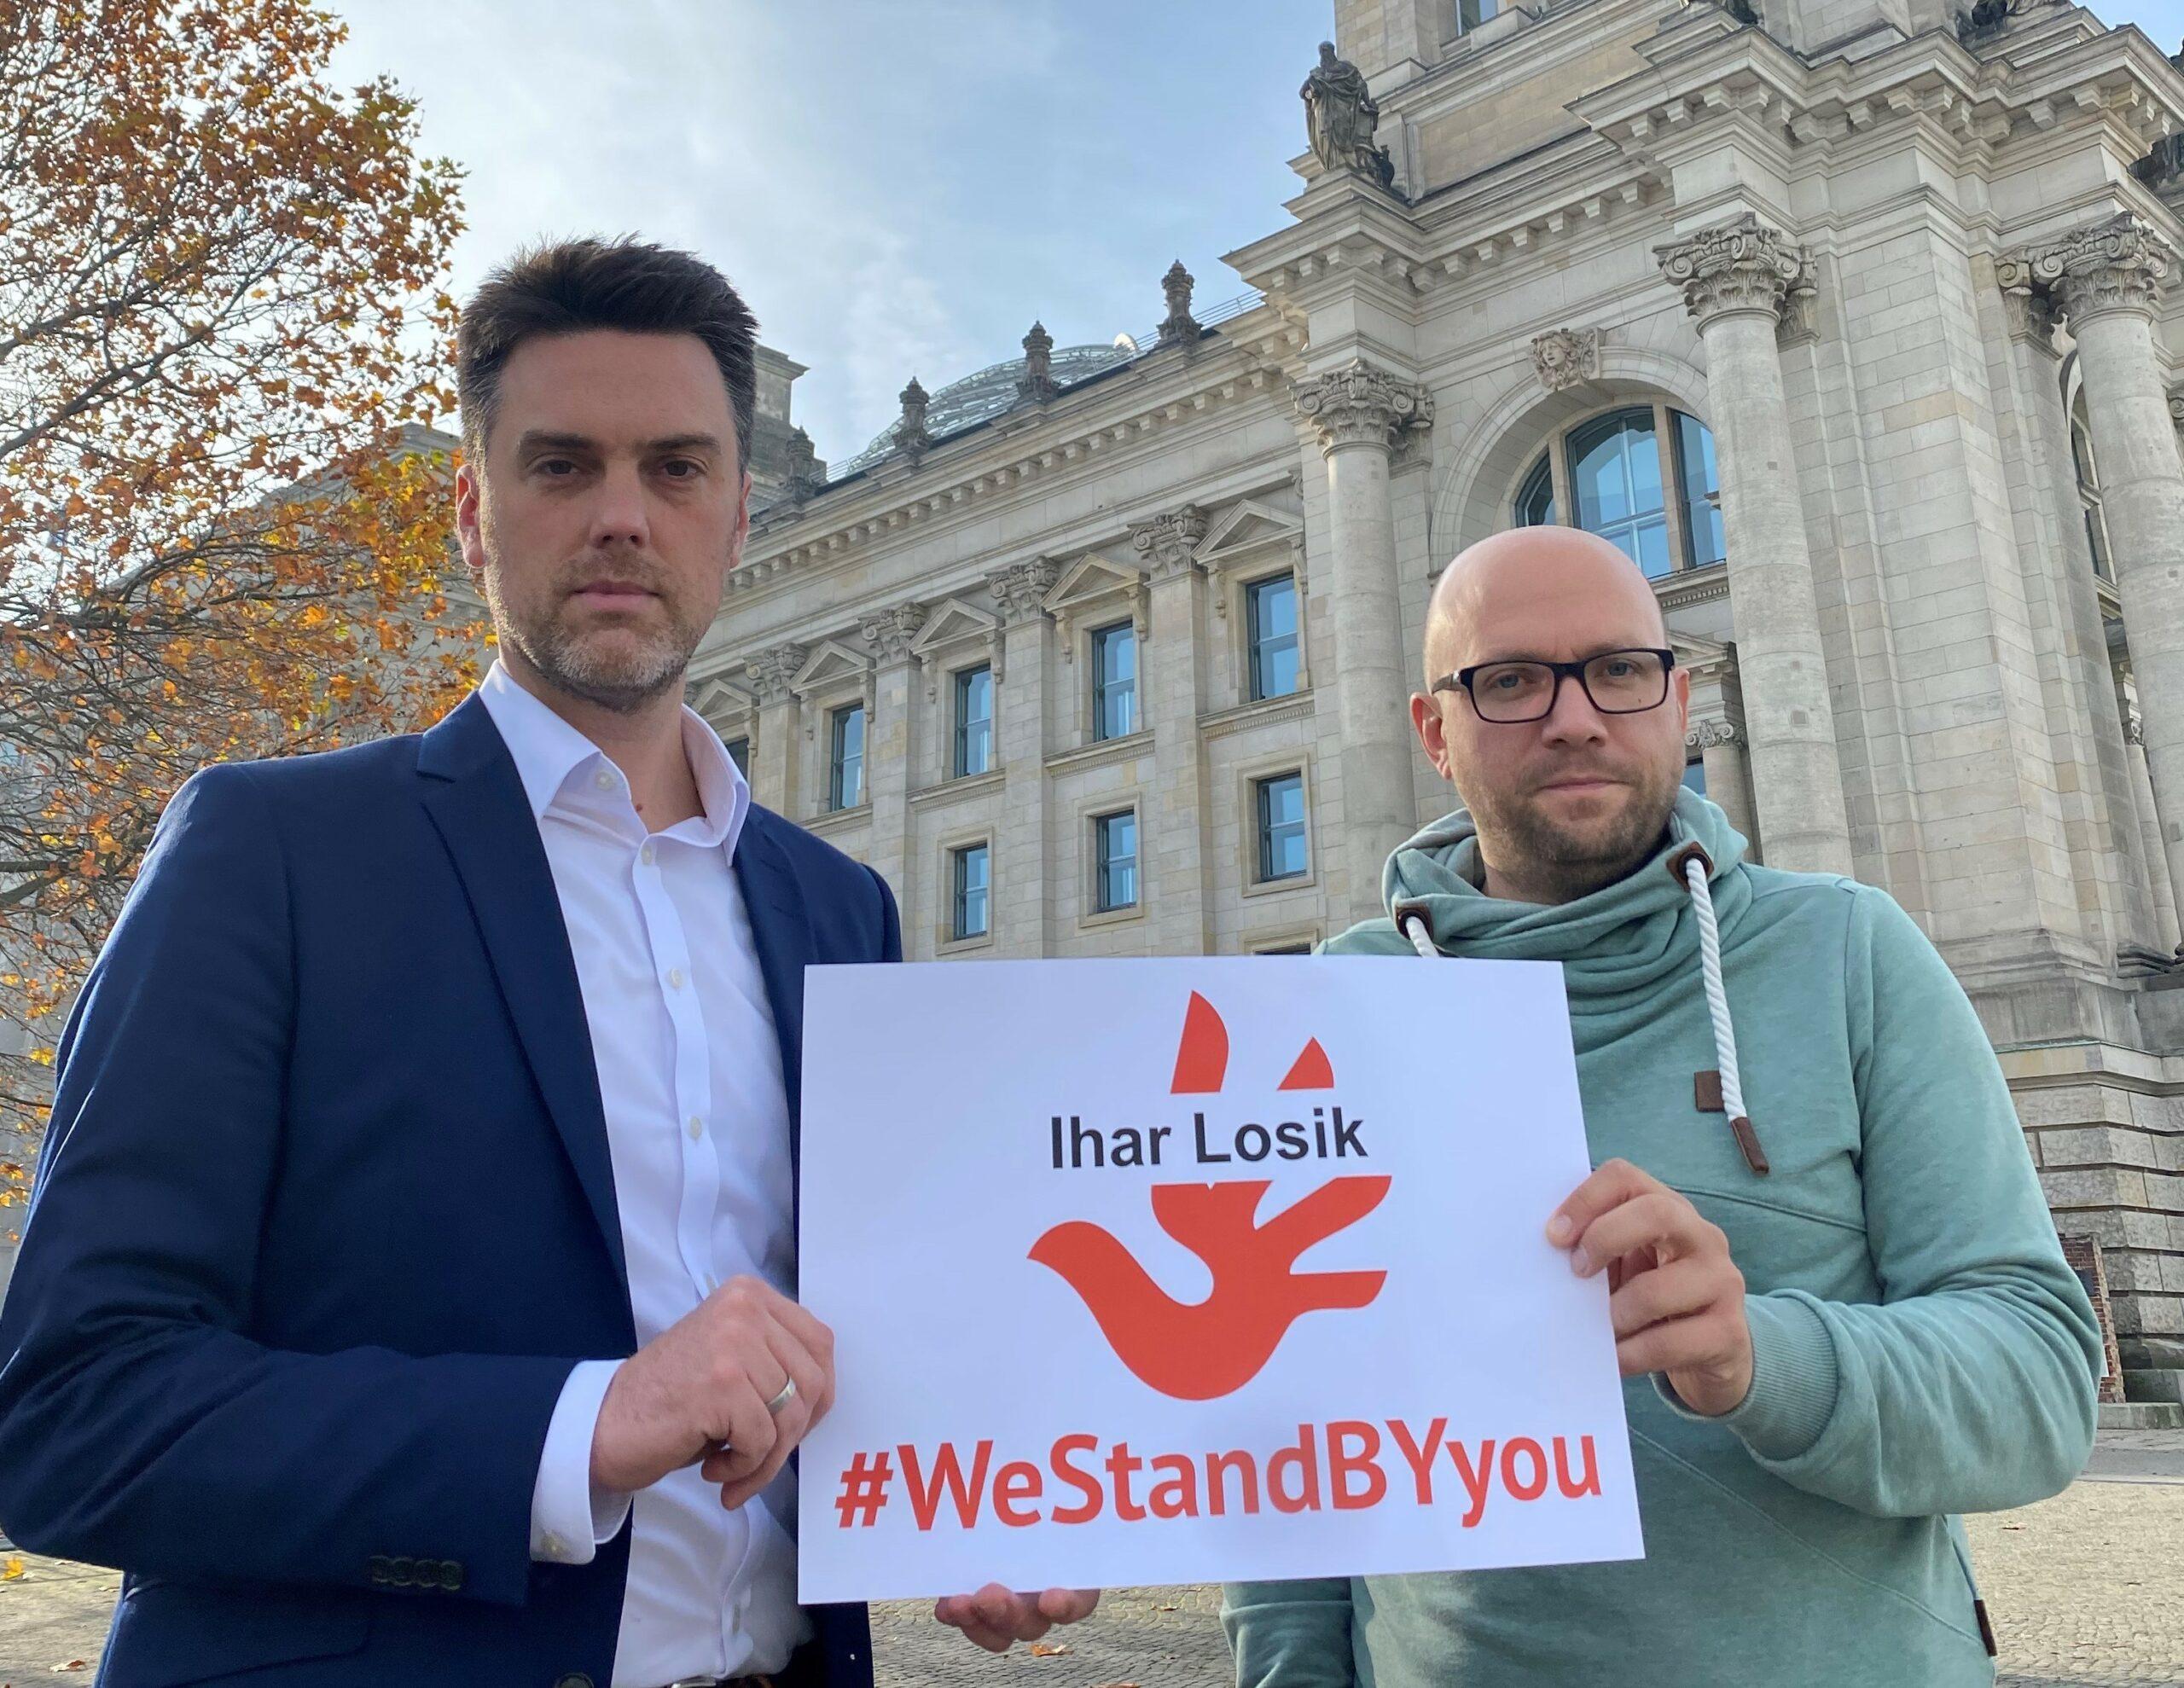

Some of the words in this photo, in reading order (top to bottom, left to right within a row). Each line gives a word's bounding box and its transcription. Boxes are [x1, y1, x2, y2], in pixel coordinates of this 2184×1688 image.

[1051, 1116, 1171, 1169] Ihar
[1194, 1107, 1368, 1163] Losik
[834, 1418, 1601, 1530] #WeStandBYyou
